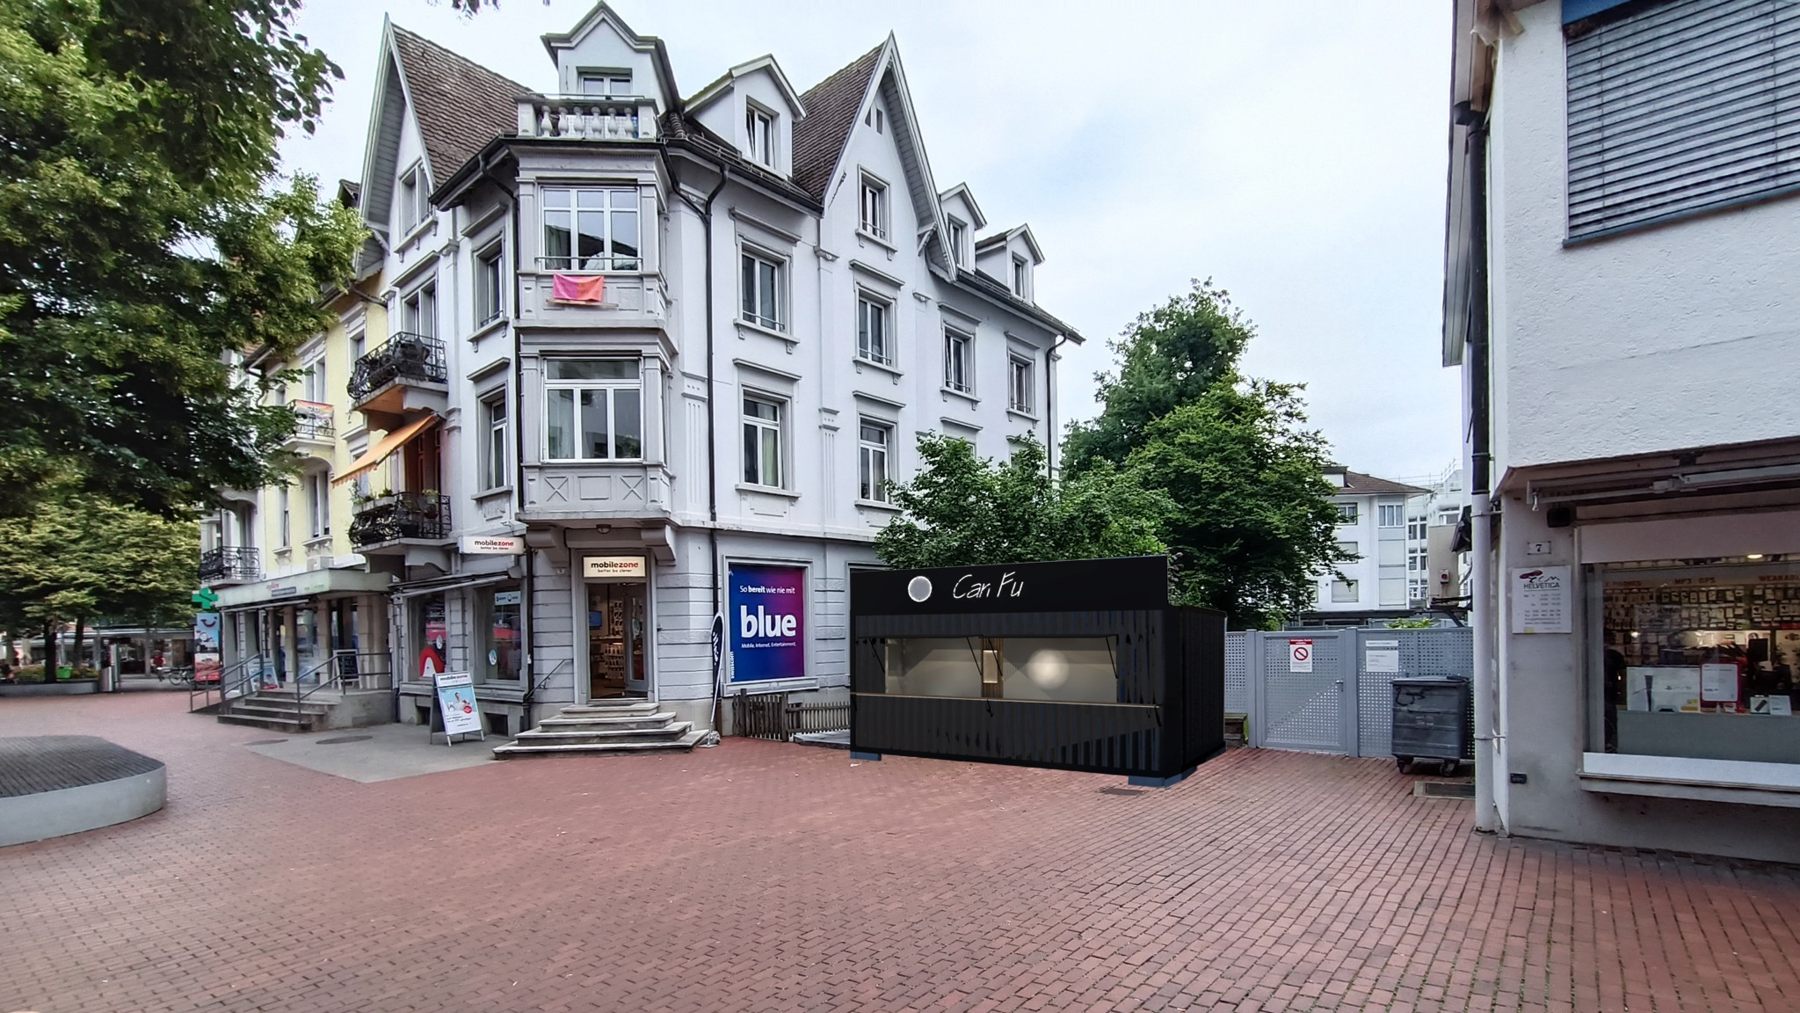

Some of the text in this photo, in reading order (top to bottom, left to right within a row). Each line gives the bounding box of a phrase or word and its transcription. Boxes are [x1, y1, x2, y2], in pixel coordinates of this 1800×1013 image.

[1535, 544, 1543, 553] 7
[740, 584, 796, 594] So bereit wie nie mit
[996, 571, 1024, 598] Fu
[1523, 582, 1561, 590] HELVETICA
[740, 605, 797, 638] blue
